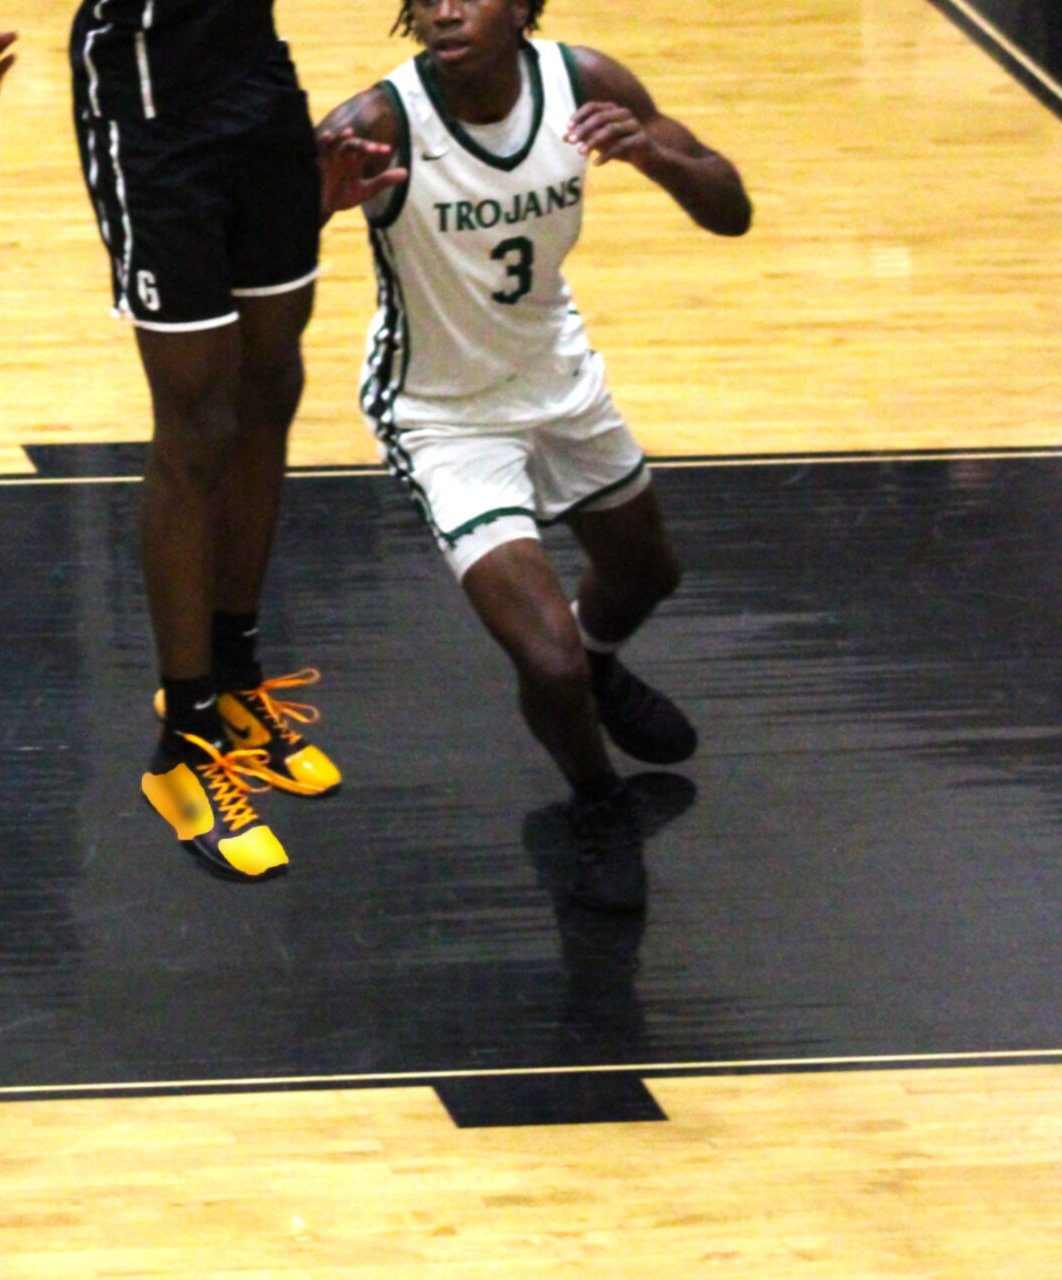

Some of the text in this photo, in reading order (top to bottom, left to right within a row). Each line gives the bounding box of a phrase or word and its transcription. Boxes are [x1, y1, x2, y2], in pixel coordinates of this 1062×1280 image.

[433, 175, 583, 233] TROJANS
[136, 269, 161, 312] G
[490, 234, 535, 306] 3
